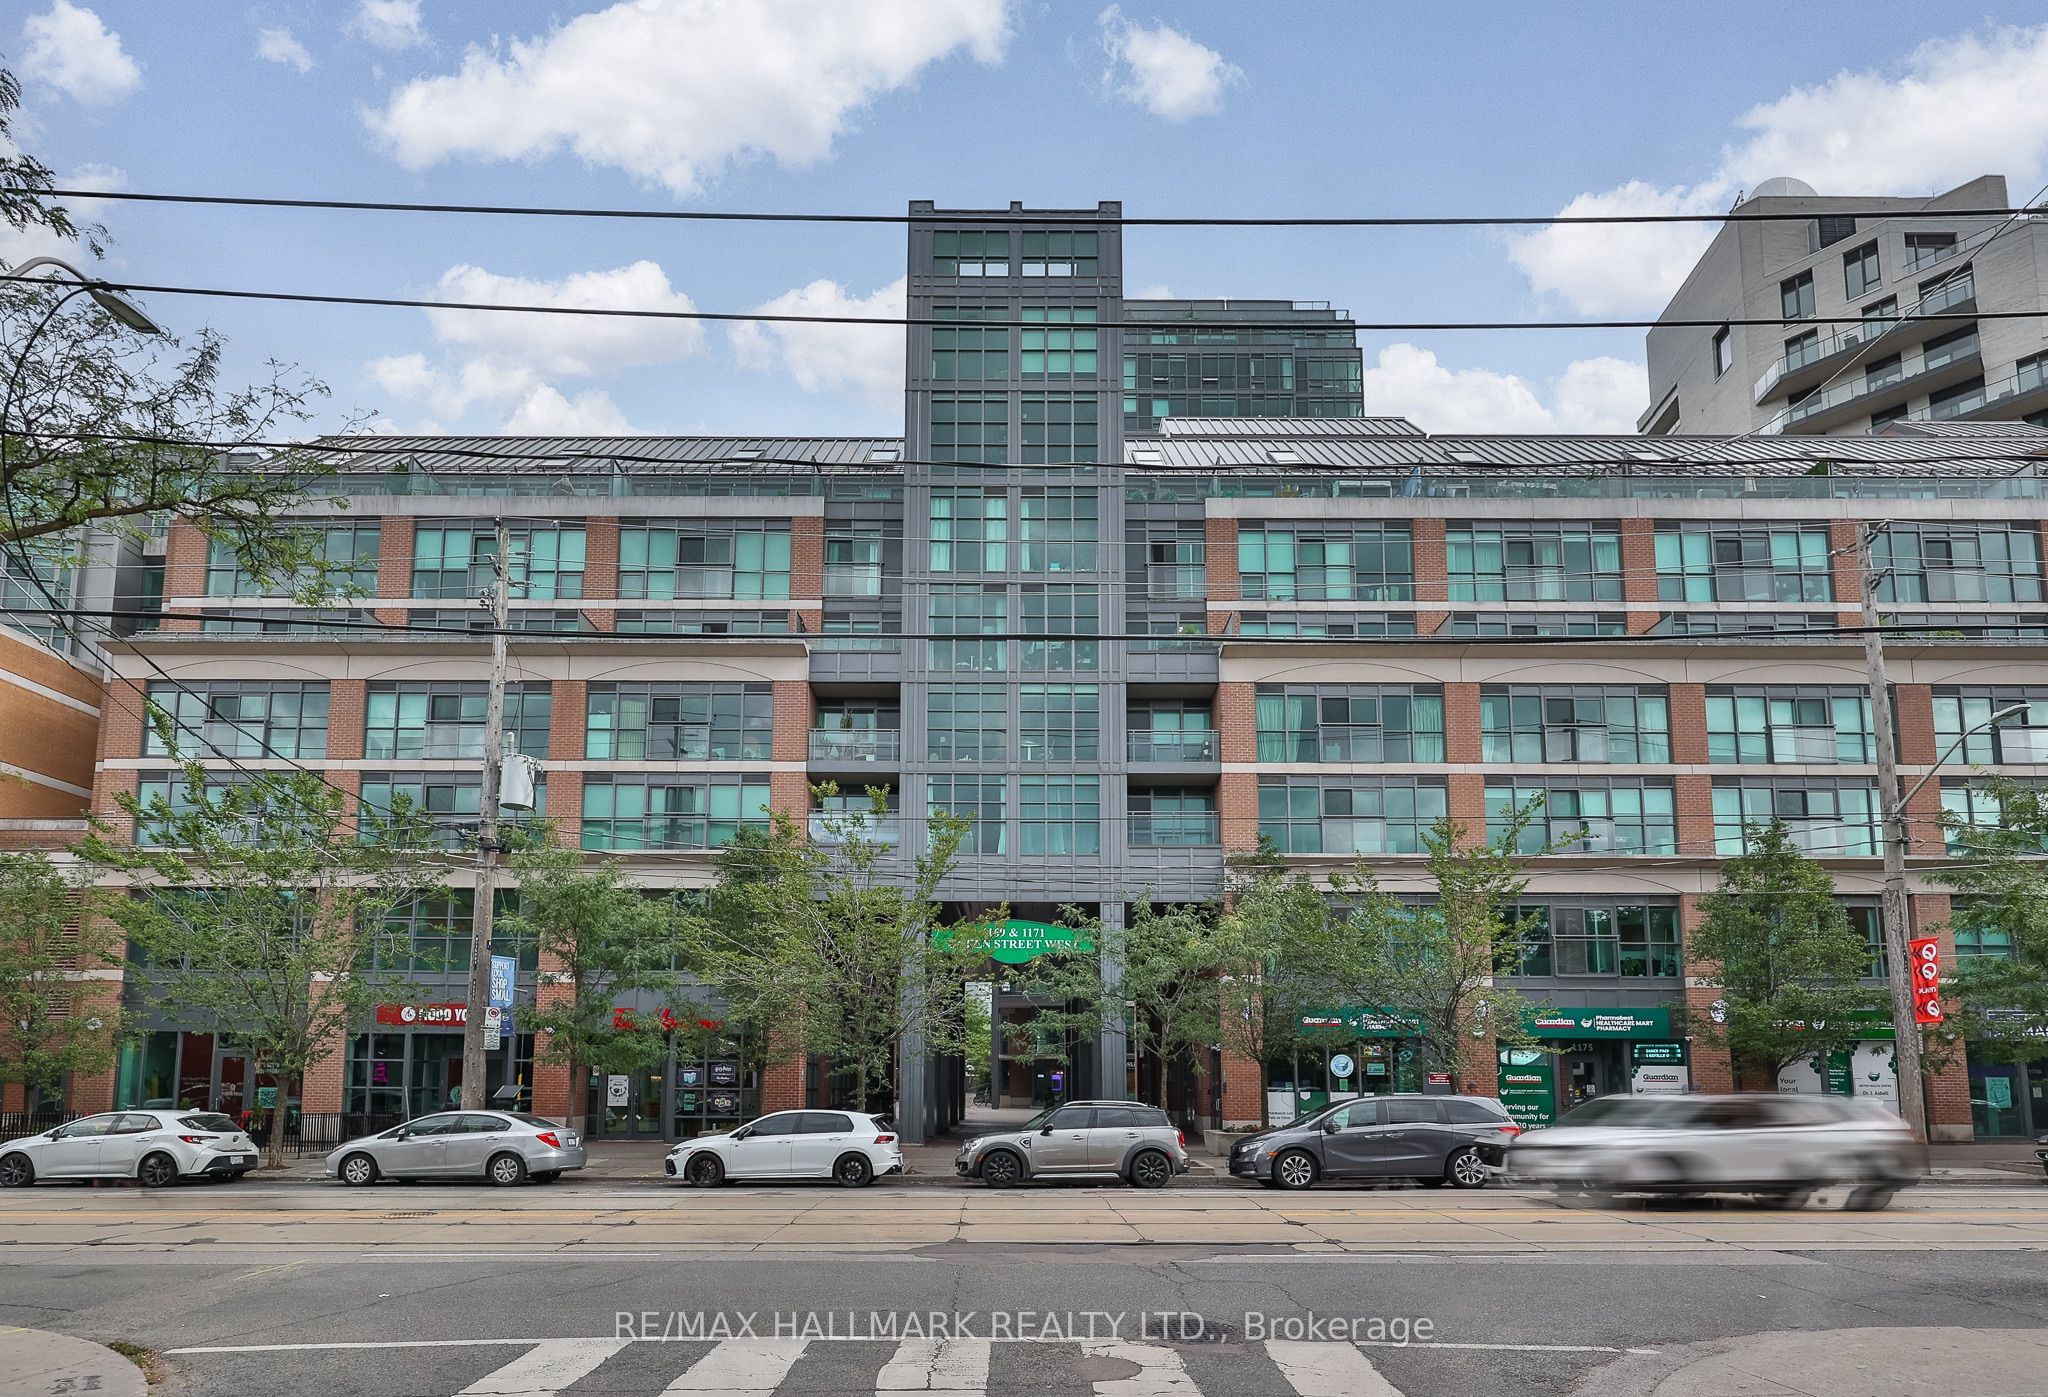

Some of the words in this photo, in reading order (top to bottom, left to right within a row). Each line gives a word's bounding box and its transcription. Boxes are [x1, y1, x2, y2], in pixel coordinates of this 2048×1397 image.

[1009, 928, 1018, 937] &
[1022, 928, 1045, 937] 1171
[994, 939, 1042, 949] STREET
[491, 960, 511, 970] SUPPORT
[491, 977, 508, 989] SHOP
[491, 988, 511, 1001] SMALL
[1572, 1043, 1593, 1051] 1175
[1505, 1074, 1542, 1082] Guardian
[1642, 1073, 1679, 1082] Guardian
[1502, 1103, 1526, 1112] erving
[1539, 1112, 1550, 1120] for
[1528, 1123, 1546, 1131] years
